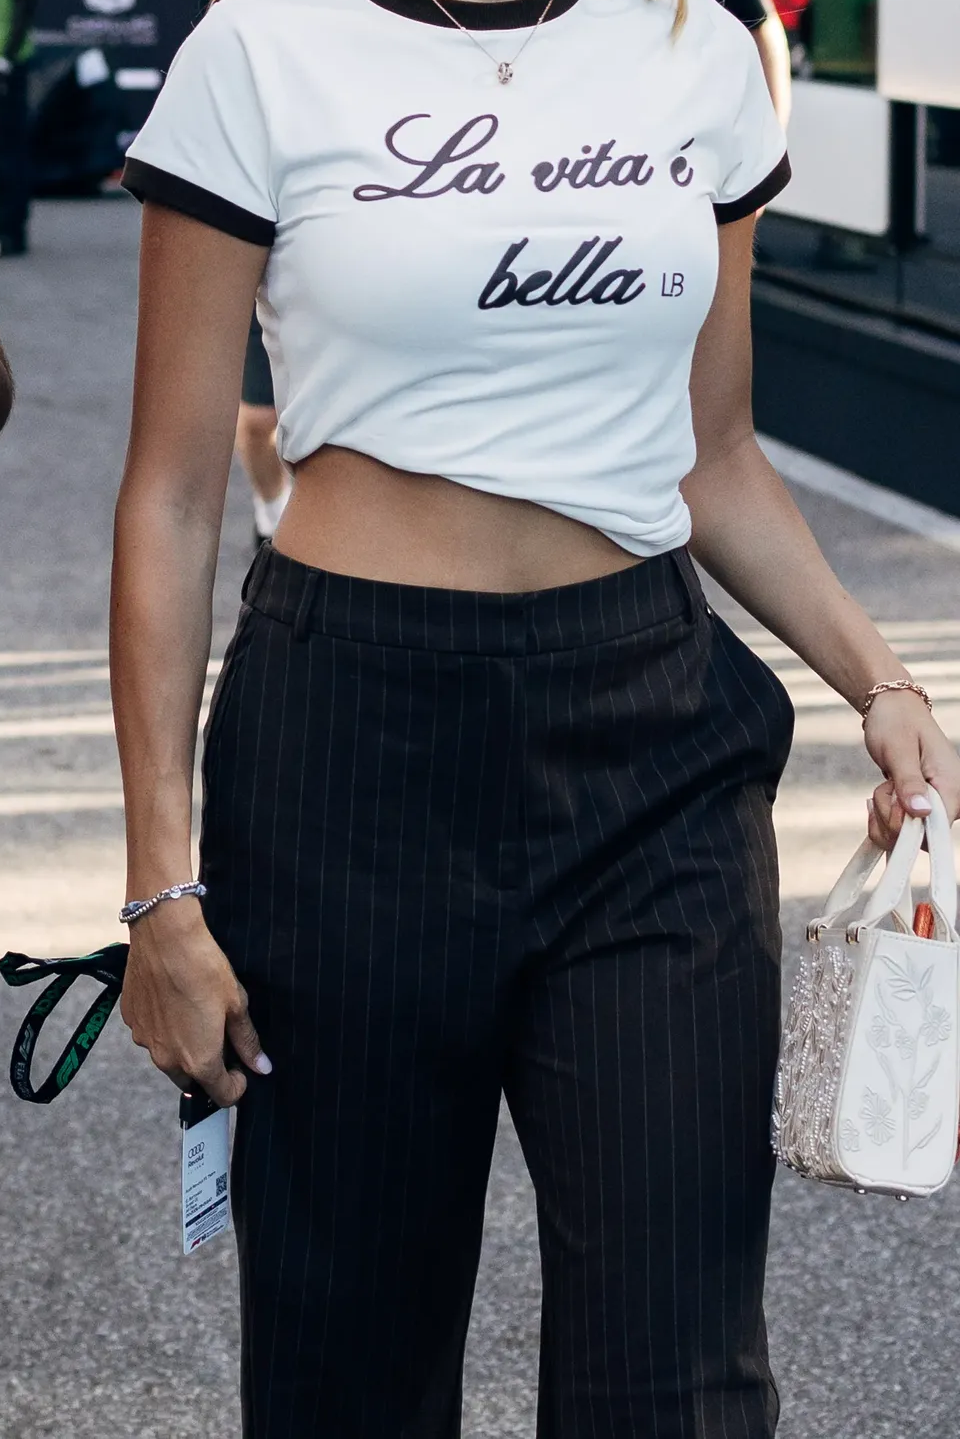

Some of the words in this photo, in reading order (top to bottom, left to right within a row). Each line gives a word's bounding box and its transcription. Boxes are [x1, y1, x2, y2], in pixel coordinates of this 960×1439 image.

[353, 113, 506, 202] La
[531, 139, 654, 192] vita
[478, 235, 646, 310] bella
[661, 272, 685, 297] LB
